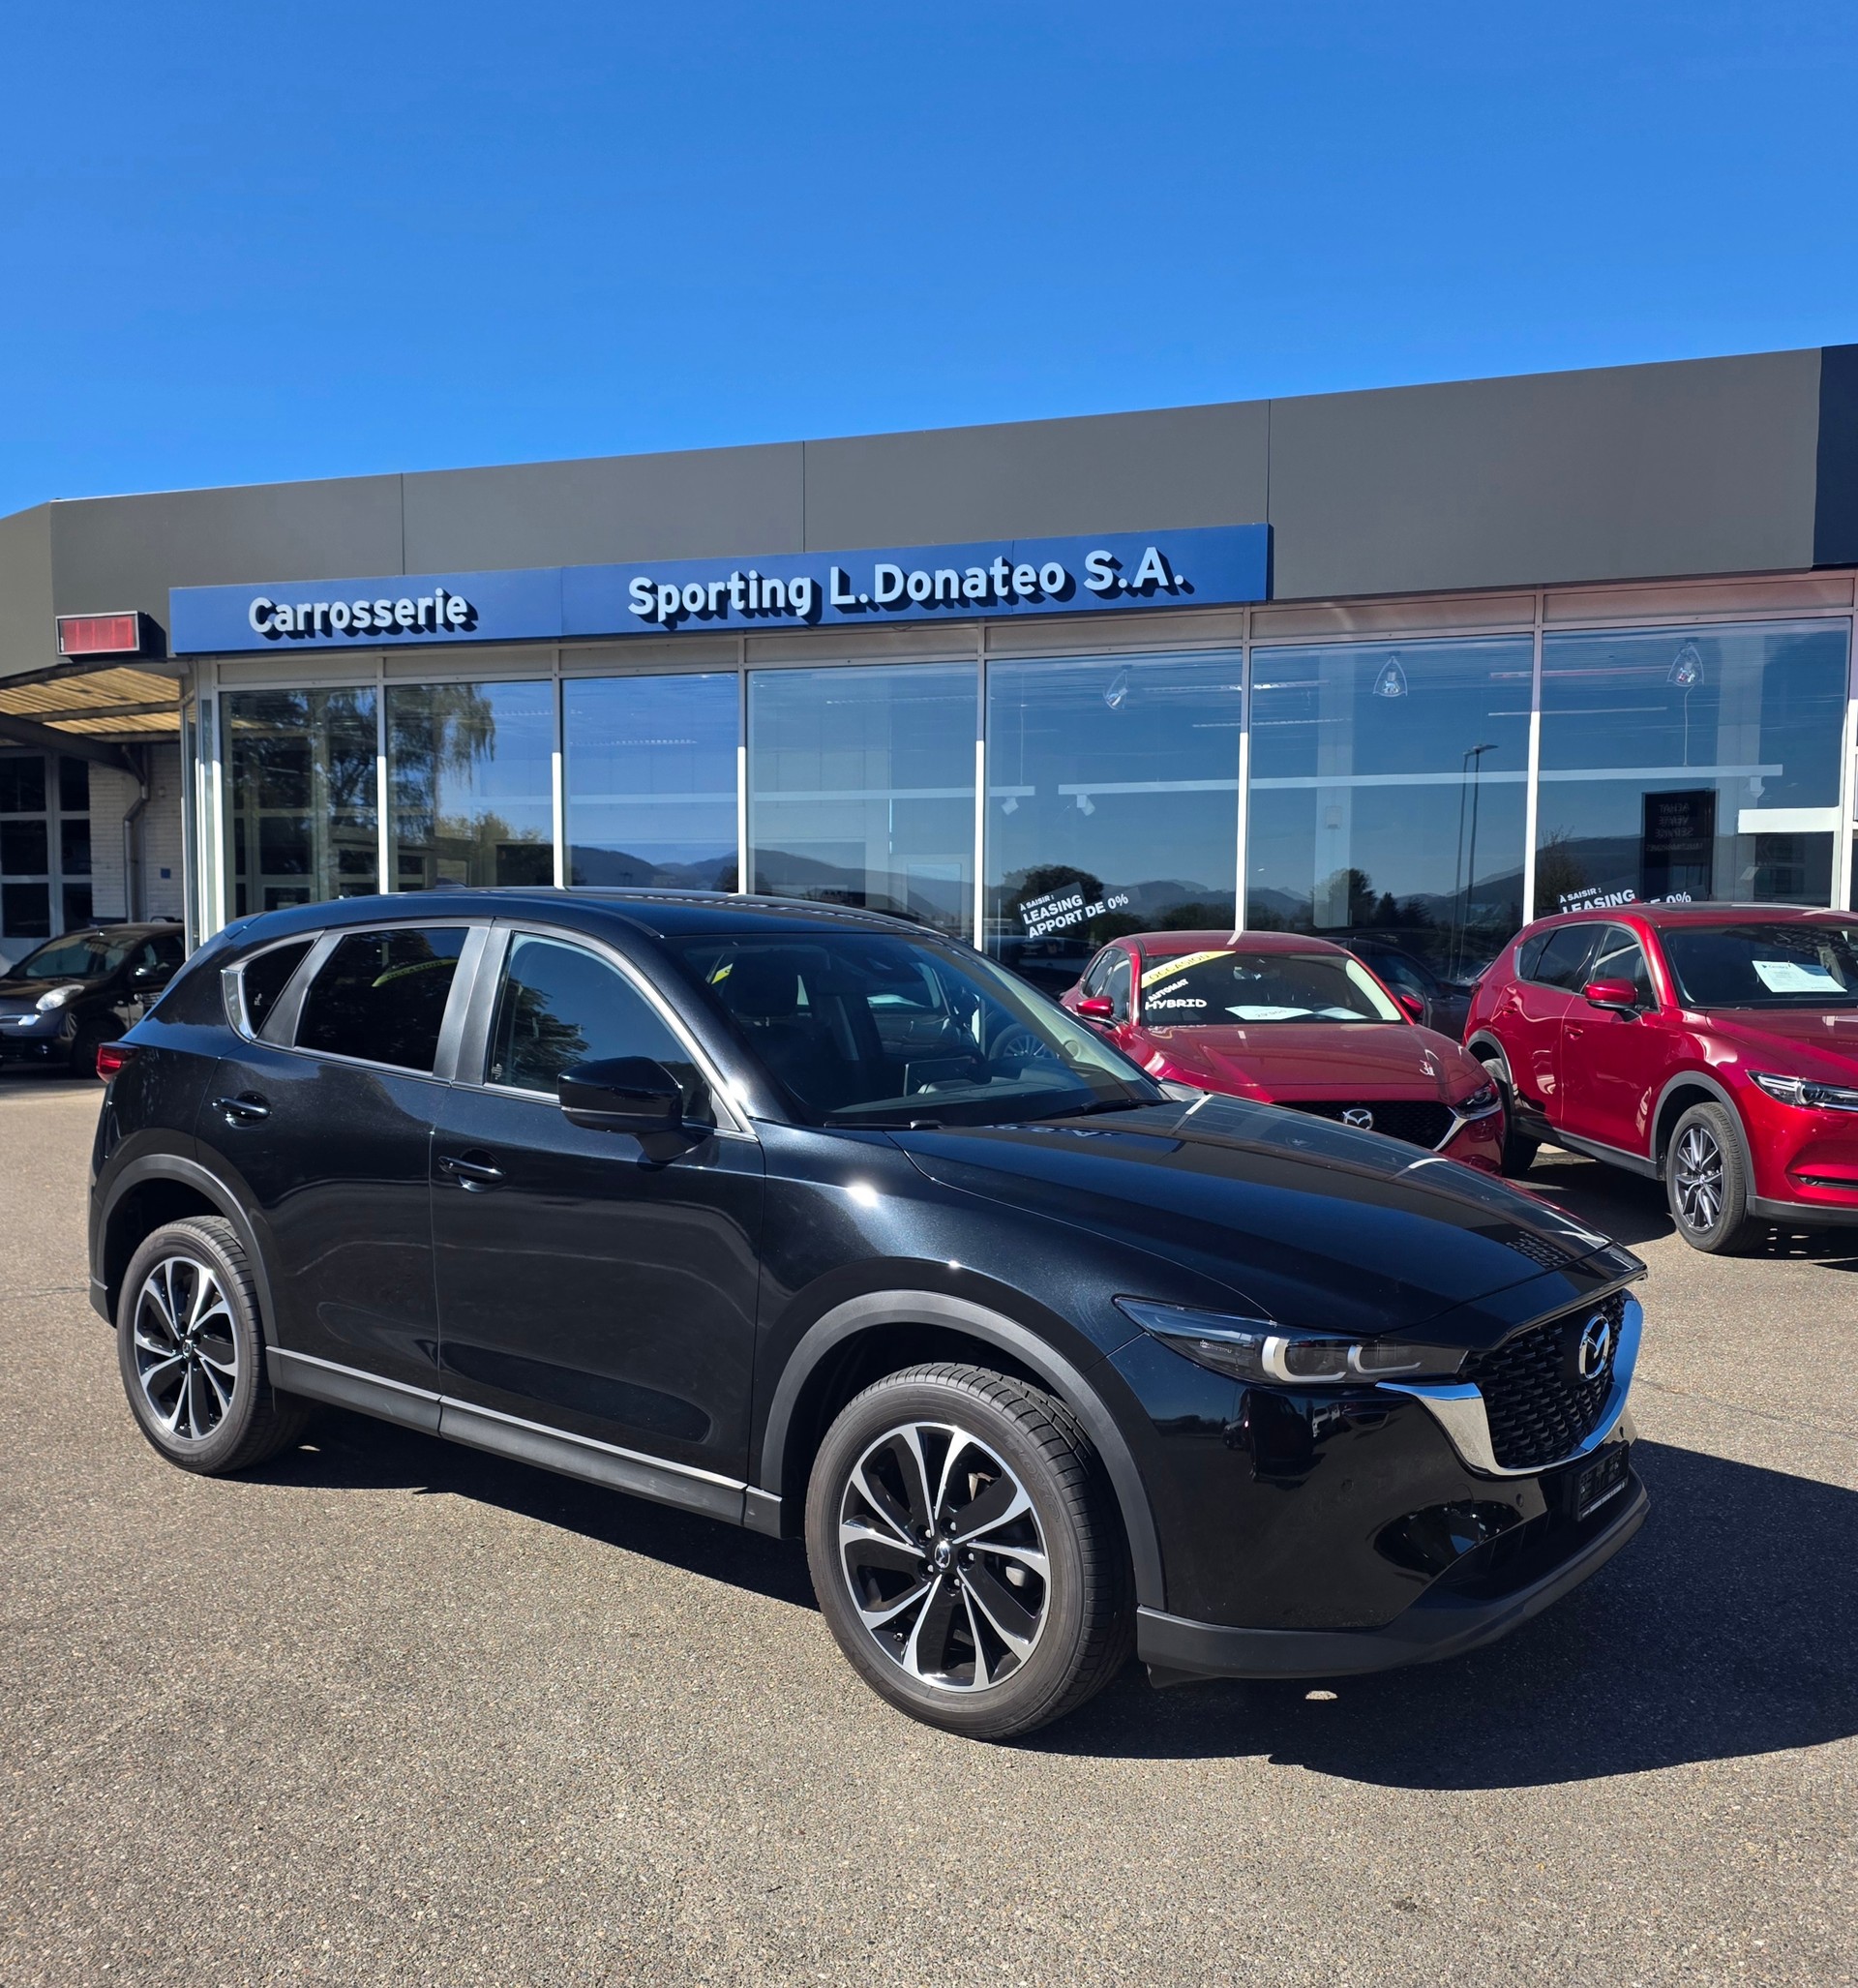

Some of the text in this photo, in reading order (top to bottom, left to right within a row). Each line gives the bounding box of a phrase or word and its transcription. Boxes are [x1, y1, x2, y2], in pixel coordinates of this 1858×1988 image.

[628, 569, 812, 623] Sporting
[1084, 547, 1184, 591] S.A.
[249, 587, 468, 633] Carrosserie
[1026, 894, 1050, 909] SAISIR
[1559, 894, 1567, 903] À
[1567, 888, 1597, 901] SAISIR
[1023, 894, 1083, 924] LEASING
[1029, 893, 1129, 939] APPORT DE 0%
[1149, 954, 1210, 980] OCCASION
[1148, 978, 1189, 1003] AUTOMAT
[1145, 998, 1208, 1011] HYBRID
